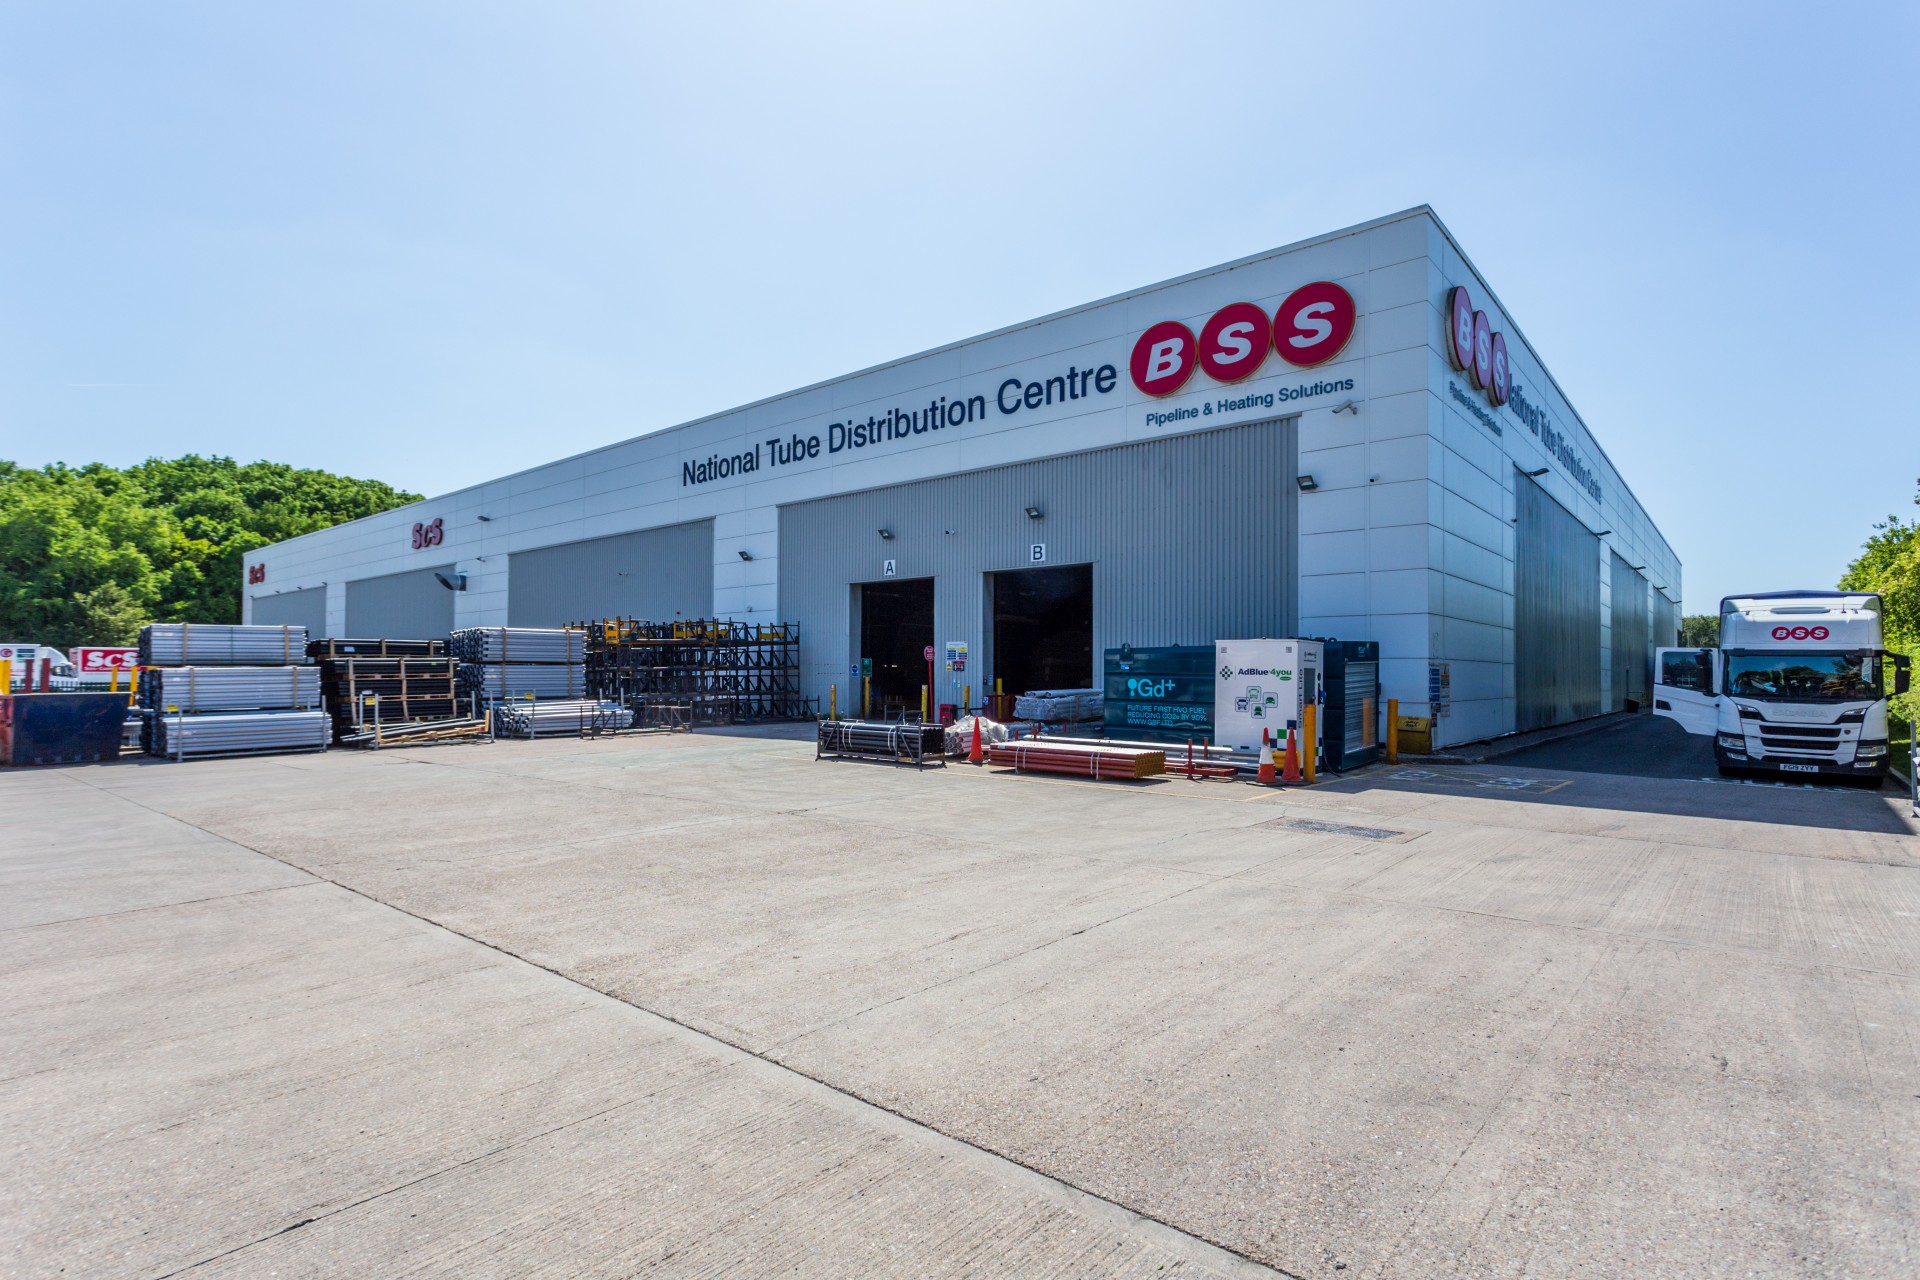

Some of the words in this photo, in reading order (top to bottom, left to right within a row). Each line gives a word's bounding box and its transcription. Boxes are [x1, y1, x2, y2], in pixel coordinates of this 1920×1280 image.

[1142, 299, 1338, 385] BSS
[1457, 302, 1506, 391] BSS
[1146, 405, 1199, 427] Pipeline
[1203, 402, 1213, 416] &
[1217, 392, 1274, 413] Heating
[1278, 378, 1354, 402] Solutions
[683, 444, 760, 487] National
[766, 434, 820, 467] Tube
[828, 395, 985, 453] Distribution
[997, 364, 1117, 415] Centre
[1032, 545, 1043, 561] B
[885, 561, 894, 574] A
[1774, 628, 1827, 638] BSS
[1127, 704, 1153, 712] FUTURE
[1173, 706, 1188, 714] HVO
[1189, 707, 1207, 715] FUEL
[1127, 711, 1161, 719] REDUCING
[1191, 714, 1207, 722] 90%
